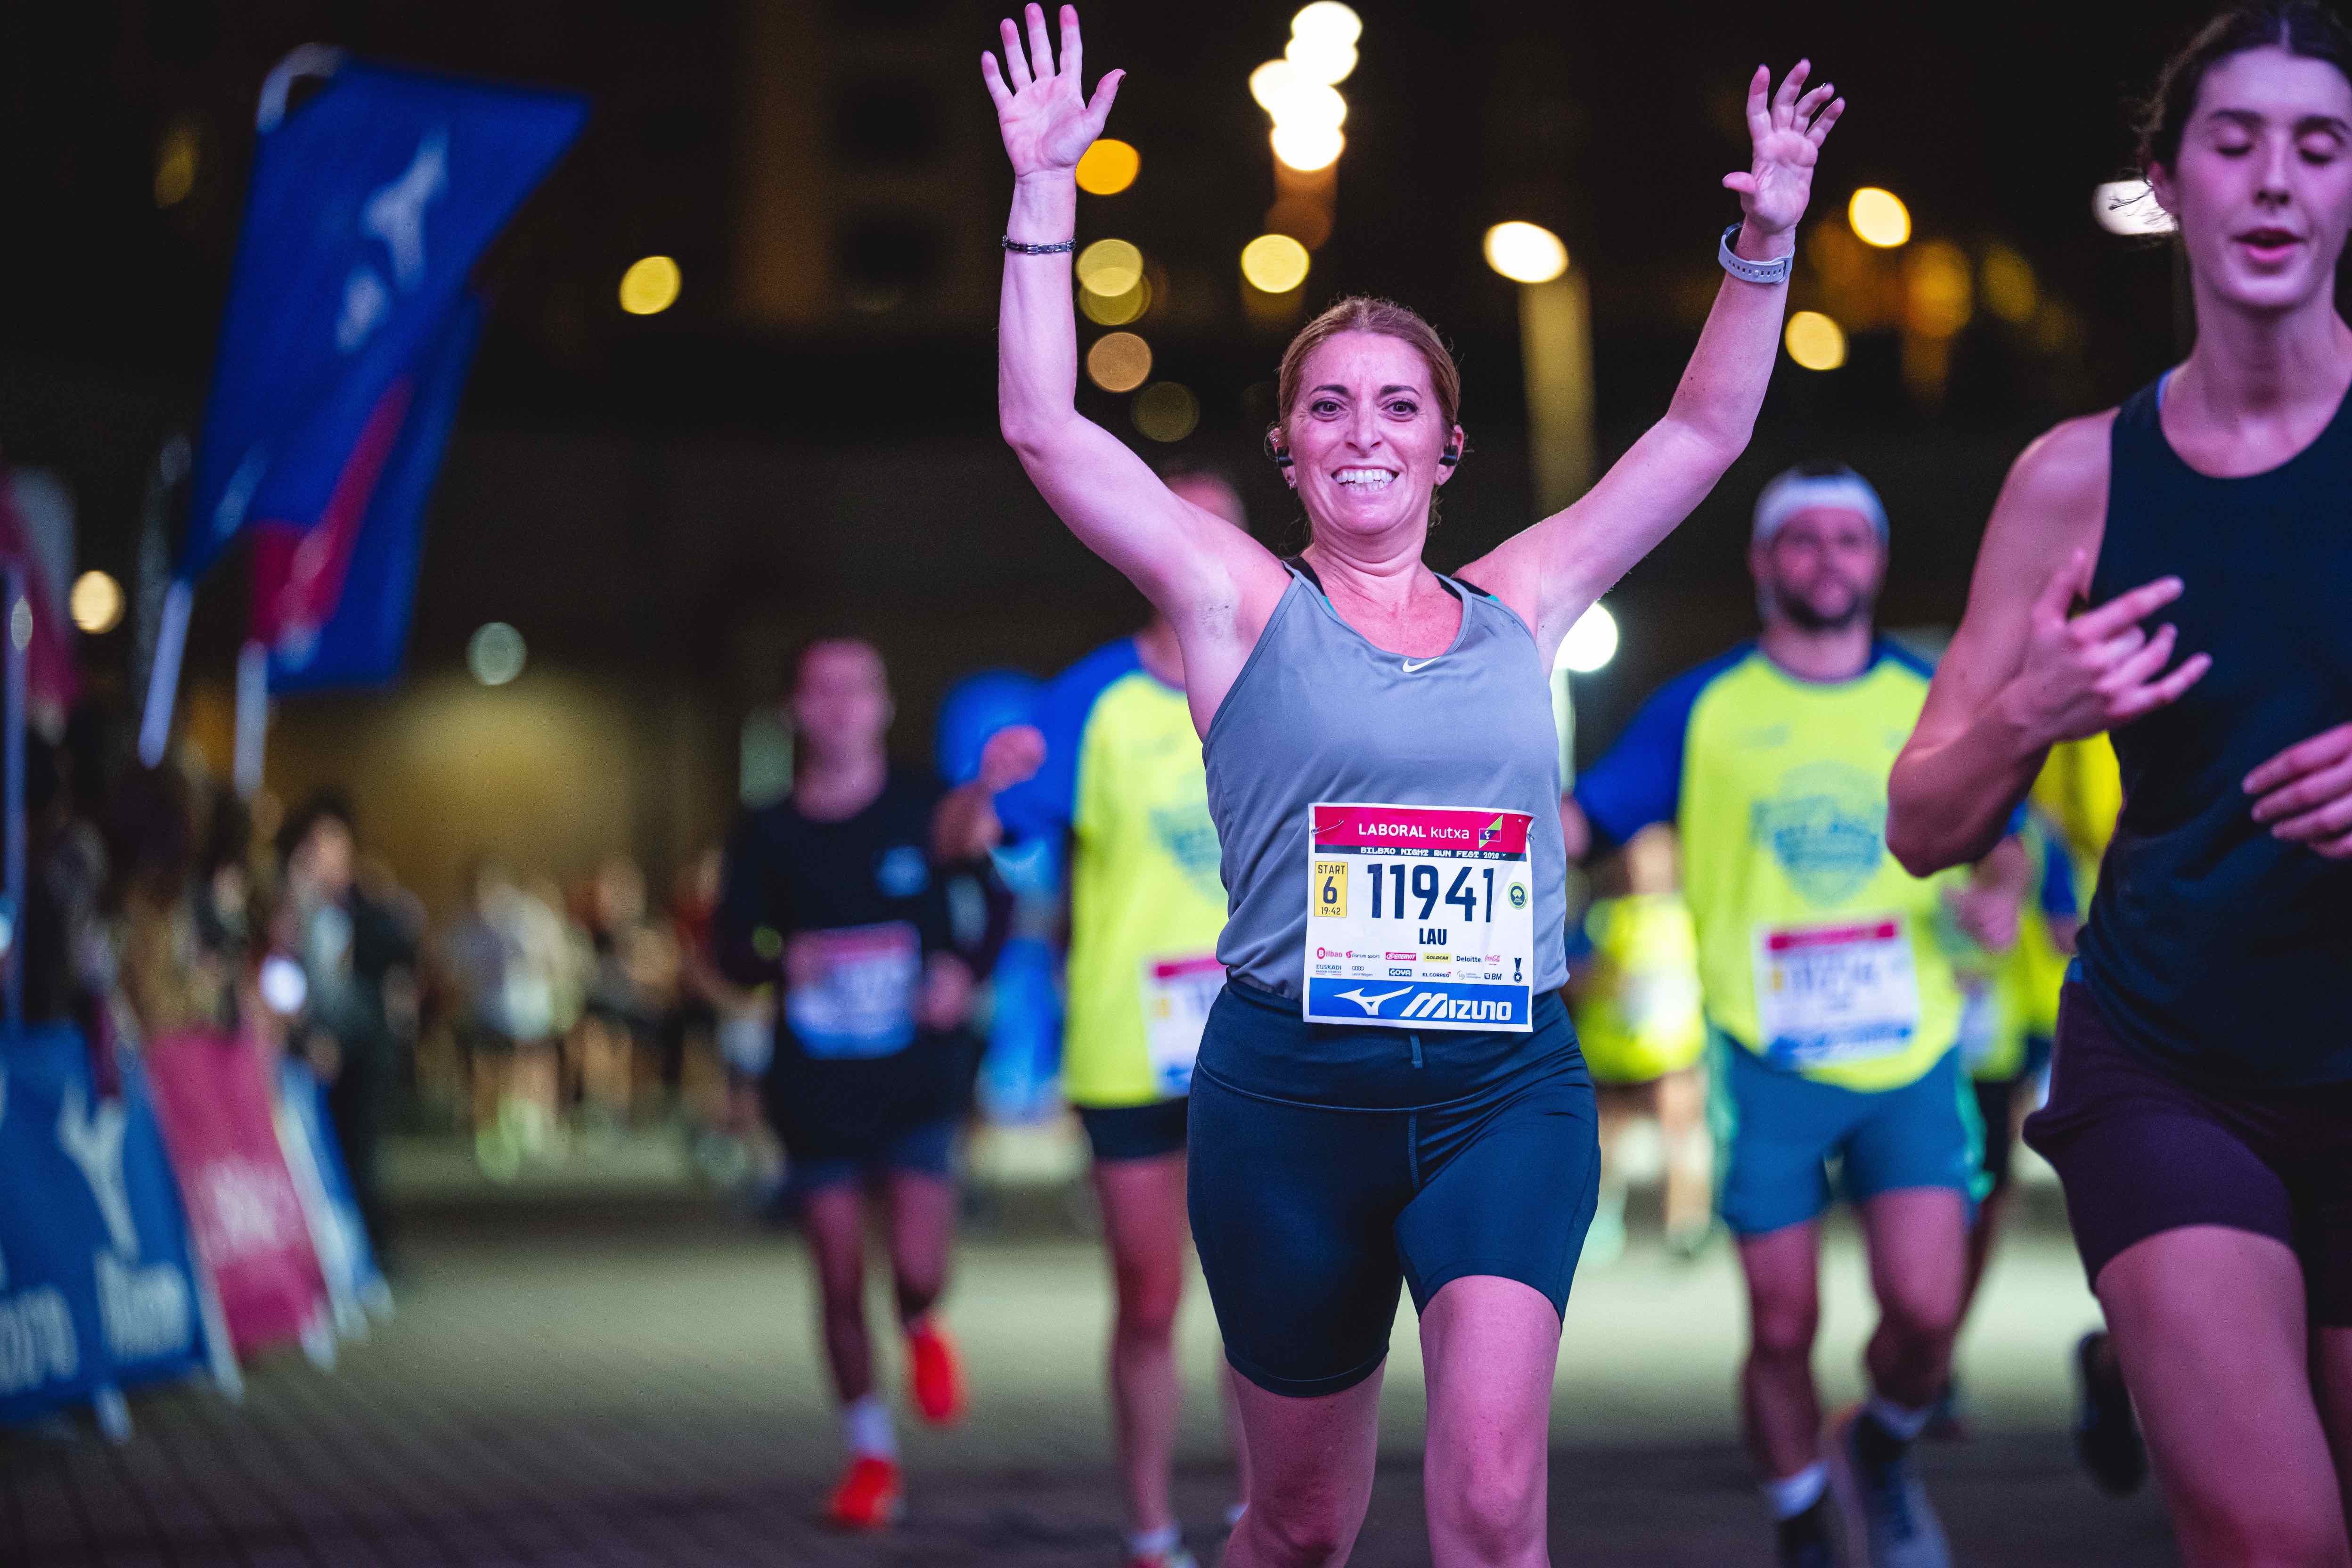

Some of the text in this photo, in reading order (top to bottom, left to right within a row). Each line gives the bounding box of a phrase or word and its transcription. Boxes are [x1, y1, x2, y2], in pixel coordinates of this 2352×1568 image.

[1359, 823, 1470, 839] LABORAL kutxa
[1401, 848, 1429, 856] NIGHT
[1318, 865, 1346, 874] START
[1323, 876, 1337, 904] 6
[1367, 864, 1494, 923] 11941
[1321, 907, 1341, 915] 19:42
[1419, 928, 1447, 945] LAU
